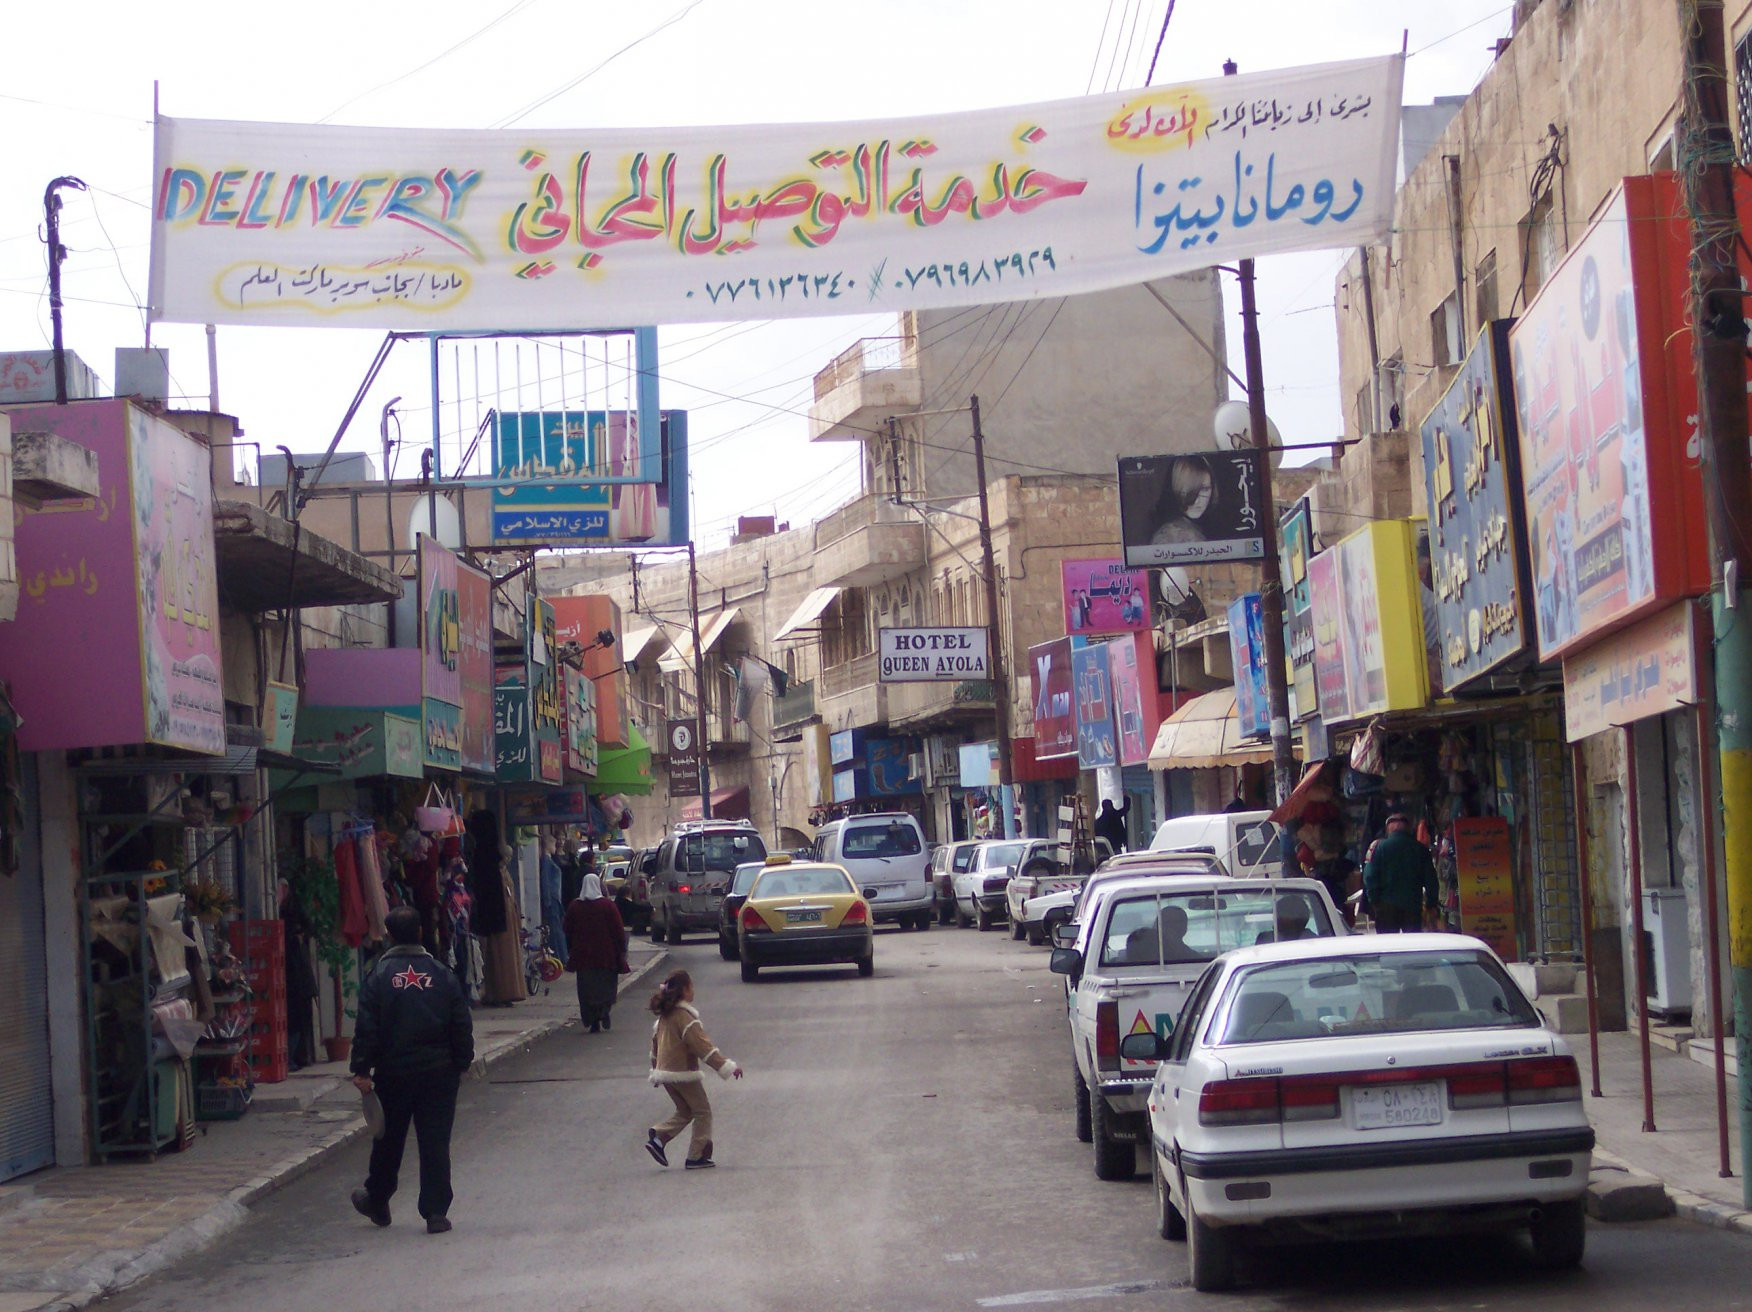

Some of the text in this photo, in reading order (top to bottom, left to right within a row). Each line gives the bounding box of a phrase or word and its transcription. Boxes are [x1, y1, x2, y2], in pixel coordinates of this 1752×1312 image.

[157, 166, 484, 262] DELIVERY
[508, 126, 1088, 280] خدمة التوصيل المجاني
[1135, 150, 1364, 255] رومانا بيتزا
[567, 515, 605, 533] للزي
[883, 656, 984, 676] QUEEN AYOLA
[895, 634, 972, 650] HOTEL
